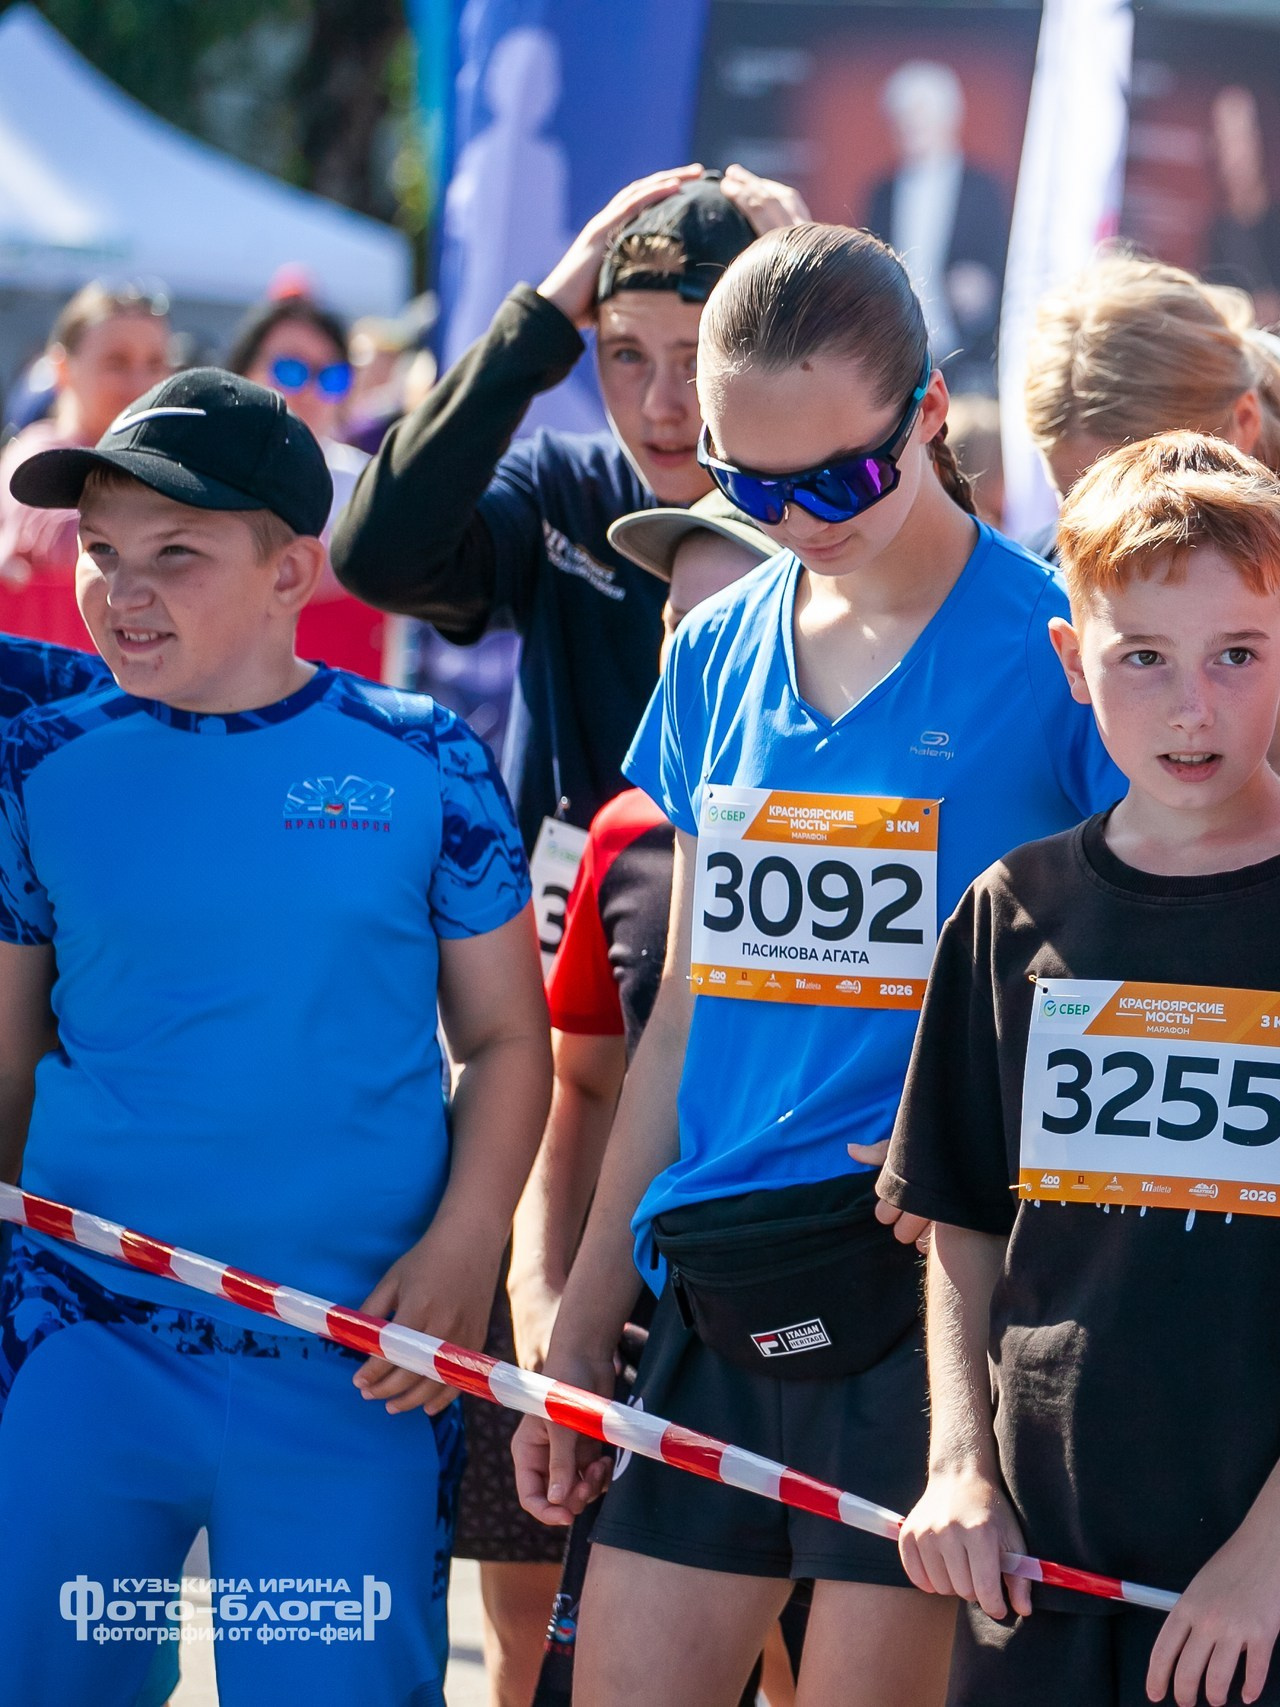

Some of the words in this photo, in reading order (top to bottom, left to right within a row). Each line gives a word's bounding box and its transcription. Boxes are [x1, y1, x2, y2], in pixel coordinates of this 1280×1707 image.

[720, 811, 746, 823] СБЕР
[769, 805, 854, 822] КРАСНОЯРСКИЕ
[789, 818, 830, 832] МОСТЫ
[885, 820, 896, 832] 3
[896, 820, 920, 833] КМ
[791, 832, 828, 841] МАРАФОН
[703, 851, 924, 945] 3092
[742, 943, 819, 961] ПАСИКОВА
[822, 949, 869, 965] АГАТА
[709, 969, 726, 980] 400
[879, 984, 913, 996] 2026
[1058, 1003, 1090, 1016] СБЕР
[1119, 998, 1225, 1015] КРАСНОЯРСКИЕ
[1145, 1011, 1194, 1025] МОСТЫ
[1260, 1015, 1271, 1028] 3
[1146, 1025, 1190, 1035] МАРАФОН
[1040, 1173, 1060, 1185] 400
[1141, 1181, 1172, 1194] Triatleta
[1239, 1188, 1277, 1203] 2026
[785, 1324, 820, 1340] ITALIAN
[790, 1335, 824, 1348] HERITAGE
